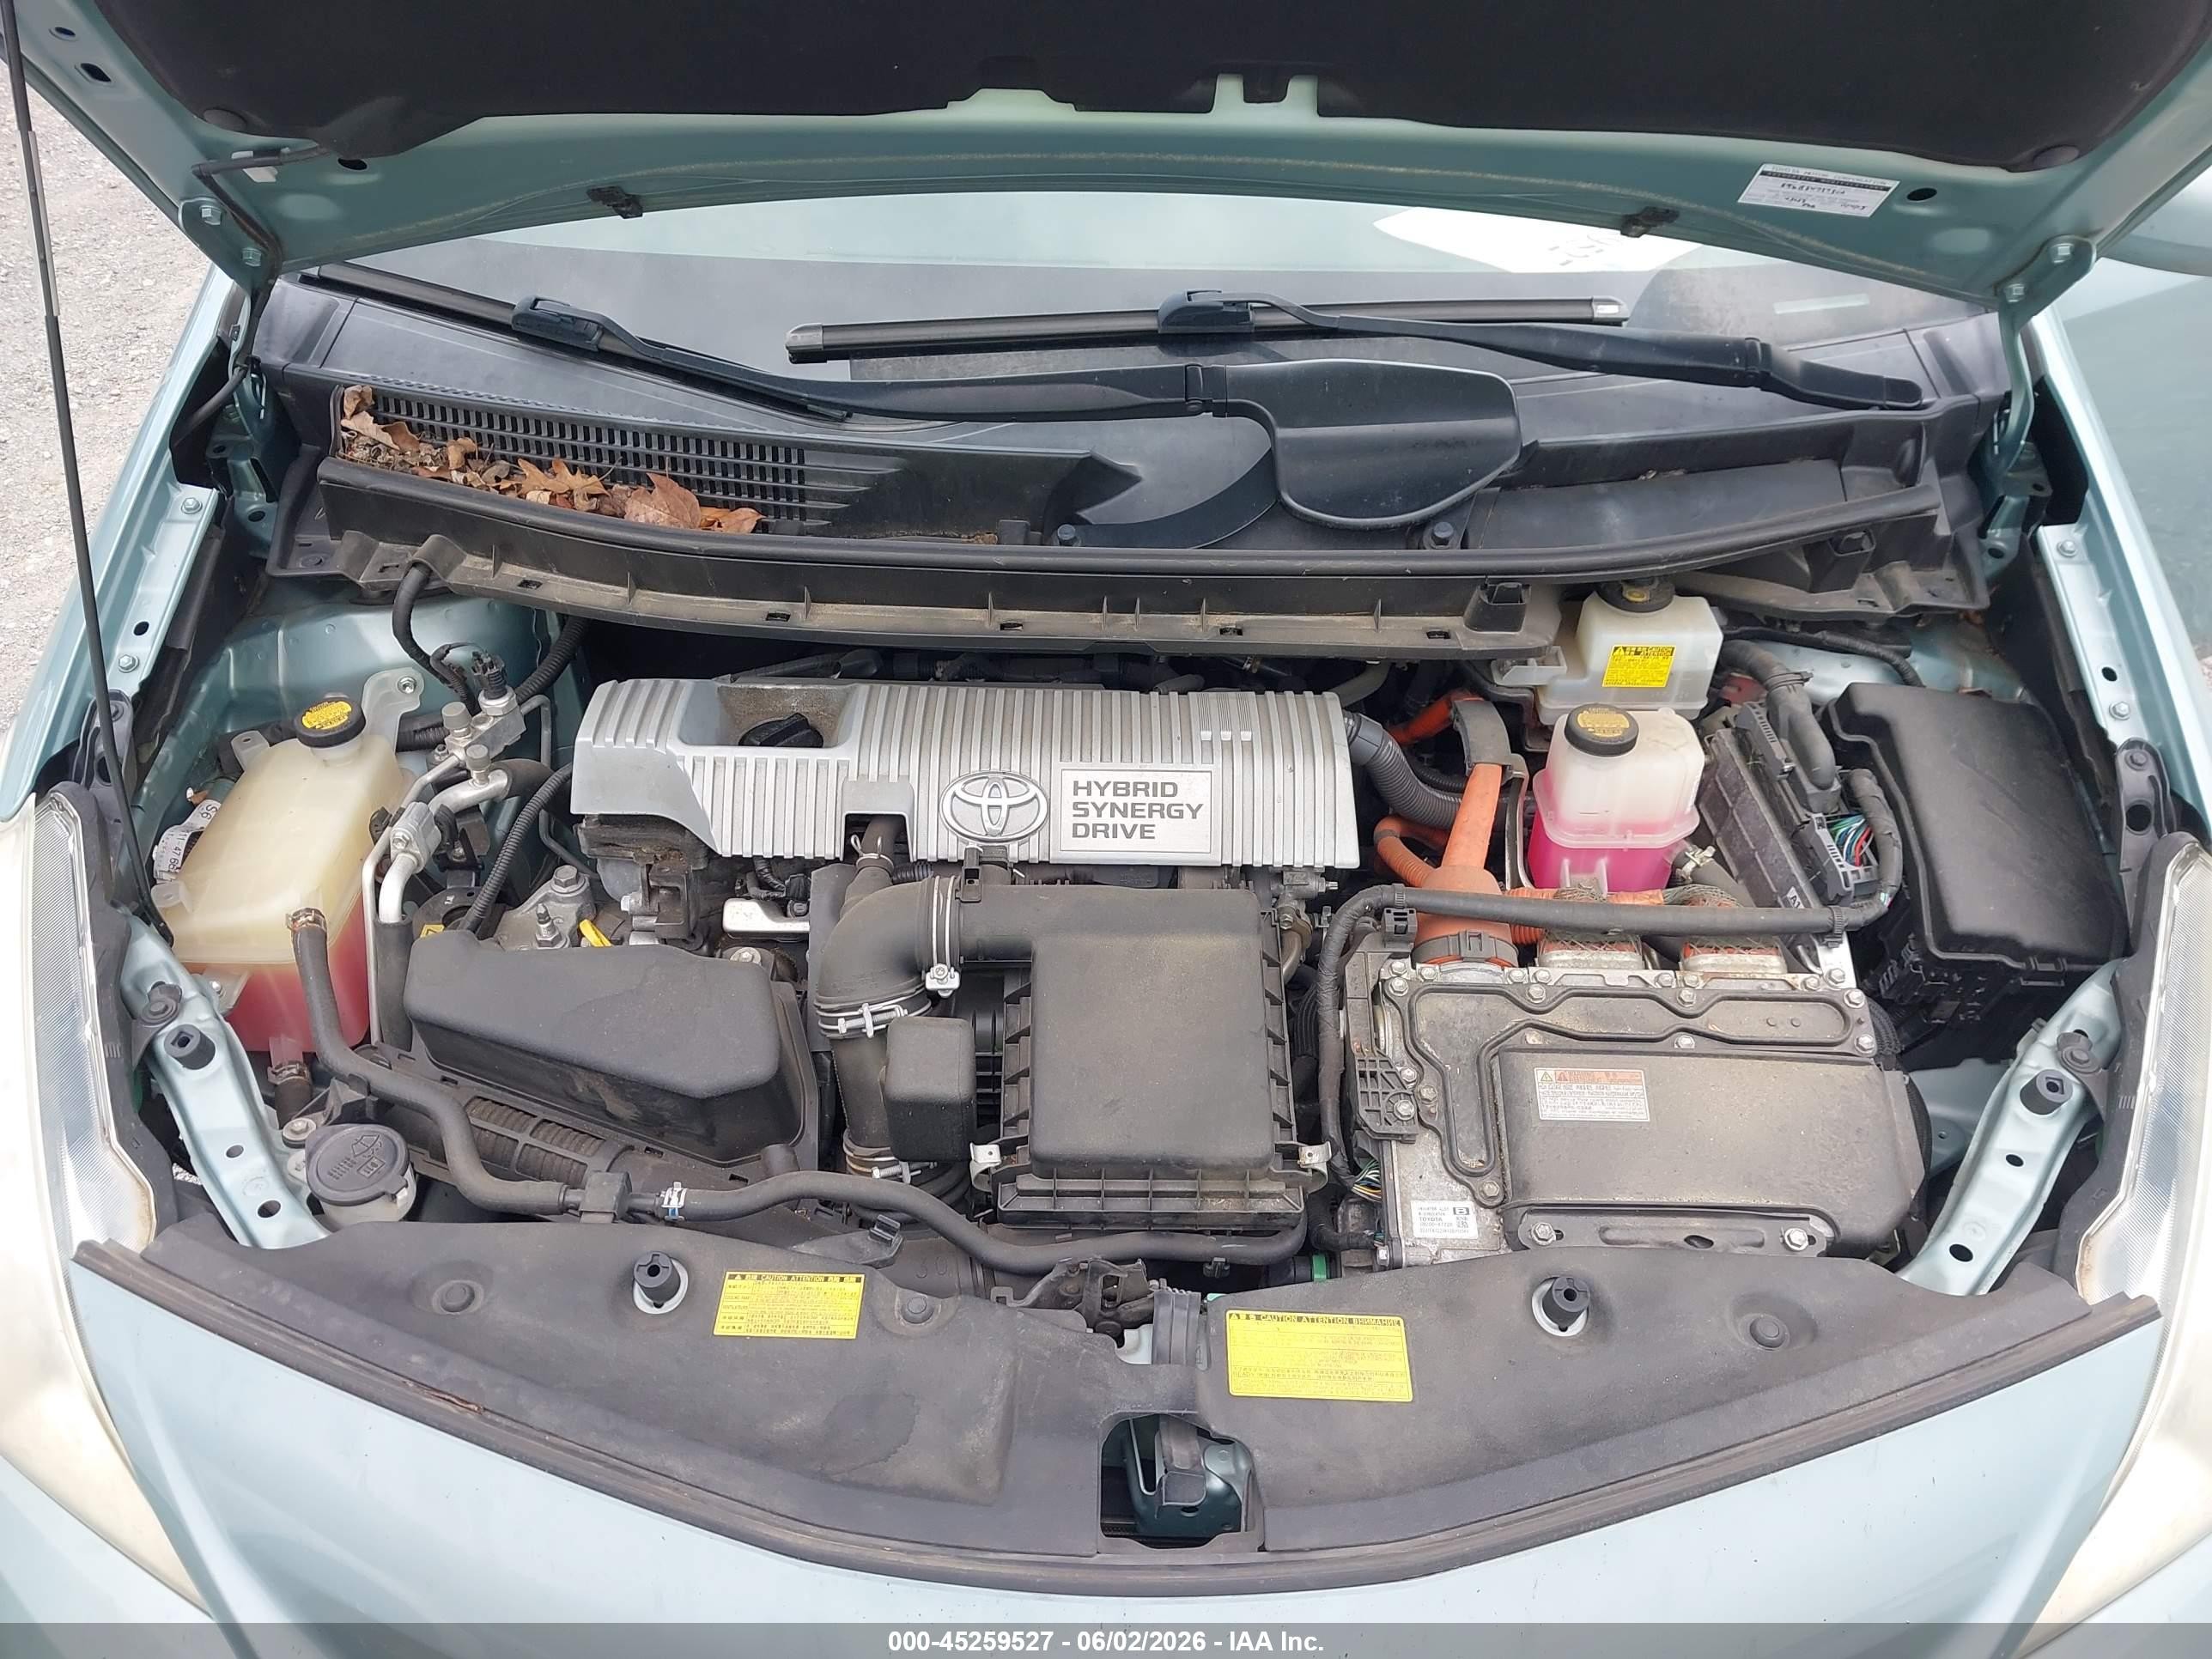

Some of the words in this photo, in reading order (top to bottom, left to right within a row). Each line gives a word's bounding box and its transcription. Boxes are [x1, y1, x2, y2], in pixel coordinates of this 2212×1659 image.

[1073, 781, 1178, 798] HYBRID
[1073, 802, 1204, 820] SYNERGY
[1072, 823, 1156, 840] DRIVE
[1303, 1316, 1349, 1325] ATTENTION
